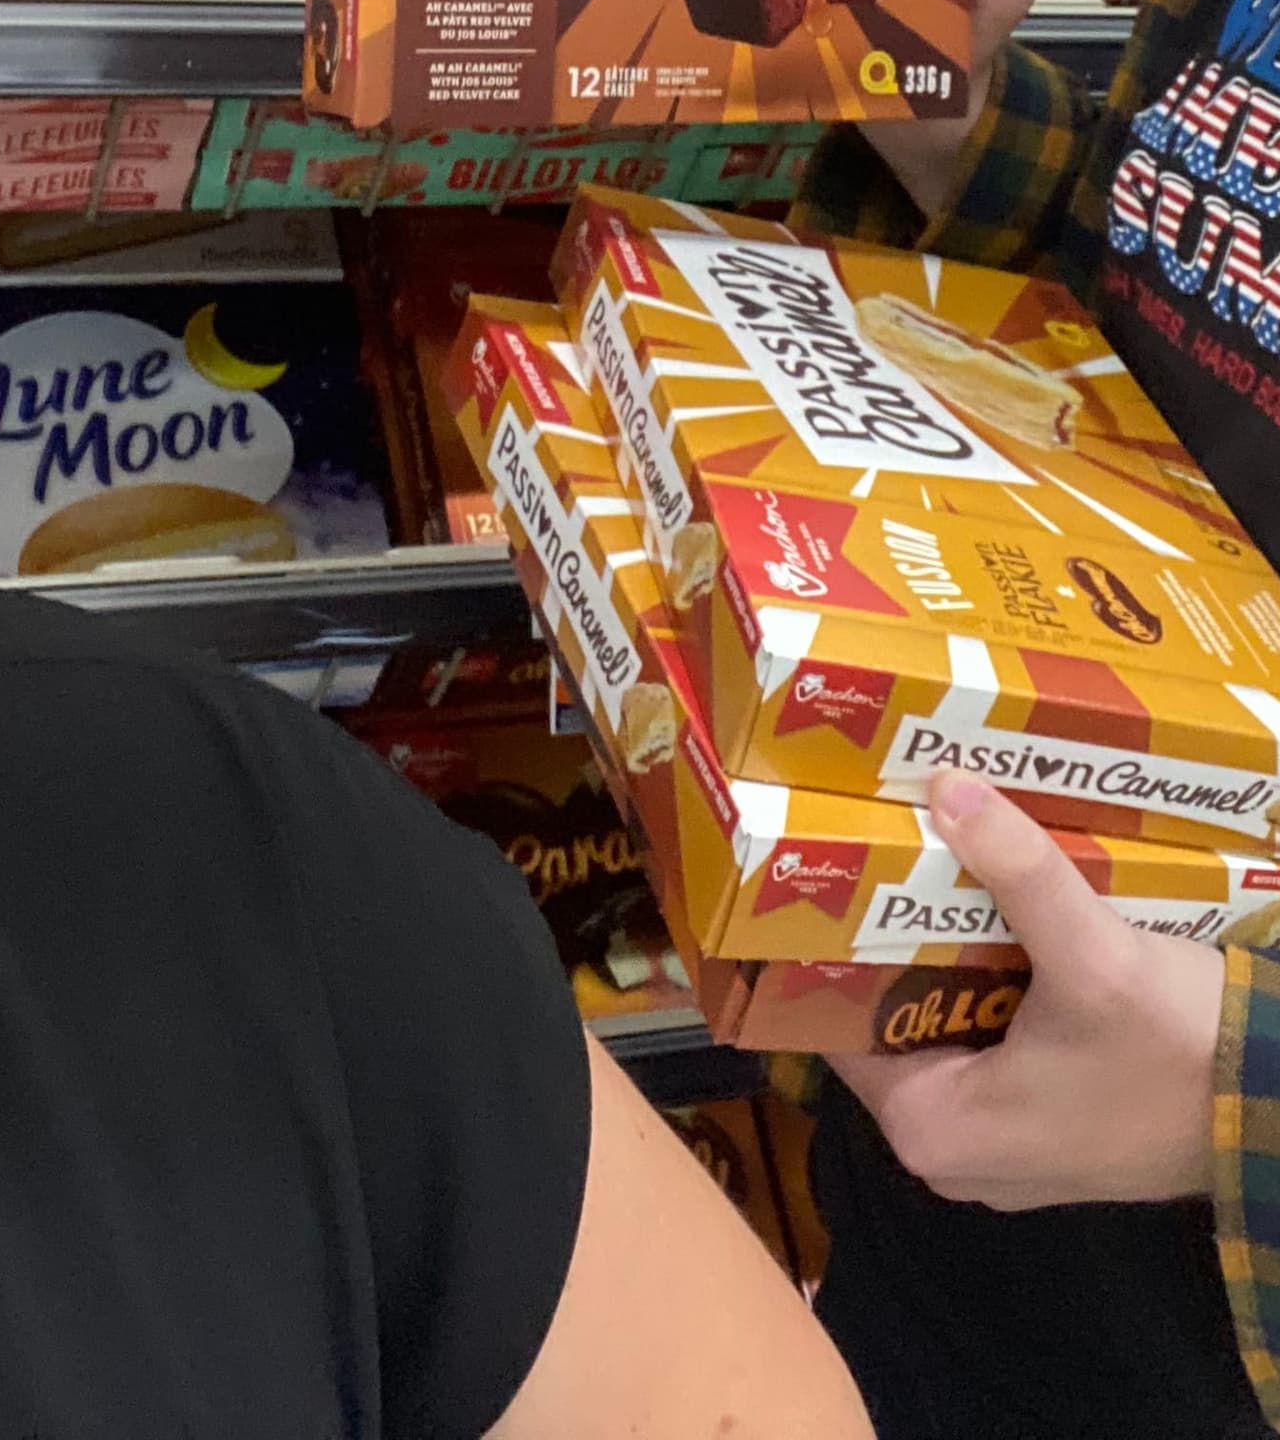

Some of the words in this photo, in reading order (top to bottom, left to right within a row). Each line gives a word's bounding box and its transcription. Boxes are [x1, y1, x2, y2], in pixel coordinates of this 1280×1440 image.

[426, 2, 443, 13] AH
[506, 2, 534, 14] AVEC
[426, 15, 442, 27] LA
[442, 13, 468, 27] PÂTE
[470, 15, 492, 27] RED
[493, 15, 533, 27] VELVET
[440, 29, 456, 40] DU
[458, 29, 476, 41] JOS
[430, 62, 446, 74] AN
[447, 62, 463, 74] AH
[431, 76, 460, 88] WITH
[461, 76, 480, 88] JOS
[567, 66, 601, 97] 12
[604, 65, 650, 81] GÂTEAUX
[904, 65, 938, 95] 336
[940, 72, 952, 99] g
[429, 89, 451, 101] RED
[452, 89, 491, 101] VELVET
[493, 89, 520, 101] CAKE
[603, 82, 635, 97] CAKES
[1193, 330, 1257, 395] HARD
[34, 398, 255, 504] Moon
[464, 511, 494, 537] 12
[881, 517, 976, 612] FUSION
[993, 542, 1068, 633] FLAKIE
[794, 672, 886, 709] Vachon
[772, 851, 861, 882] Vachon
